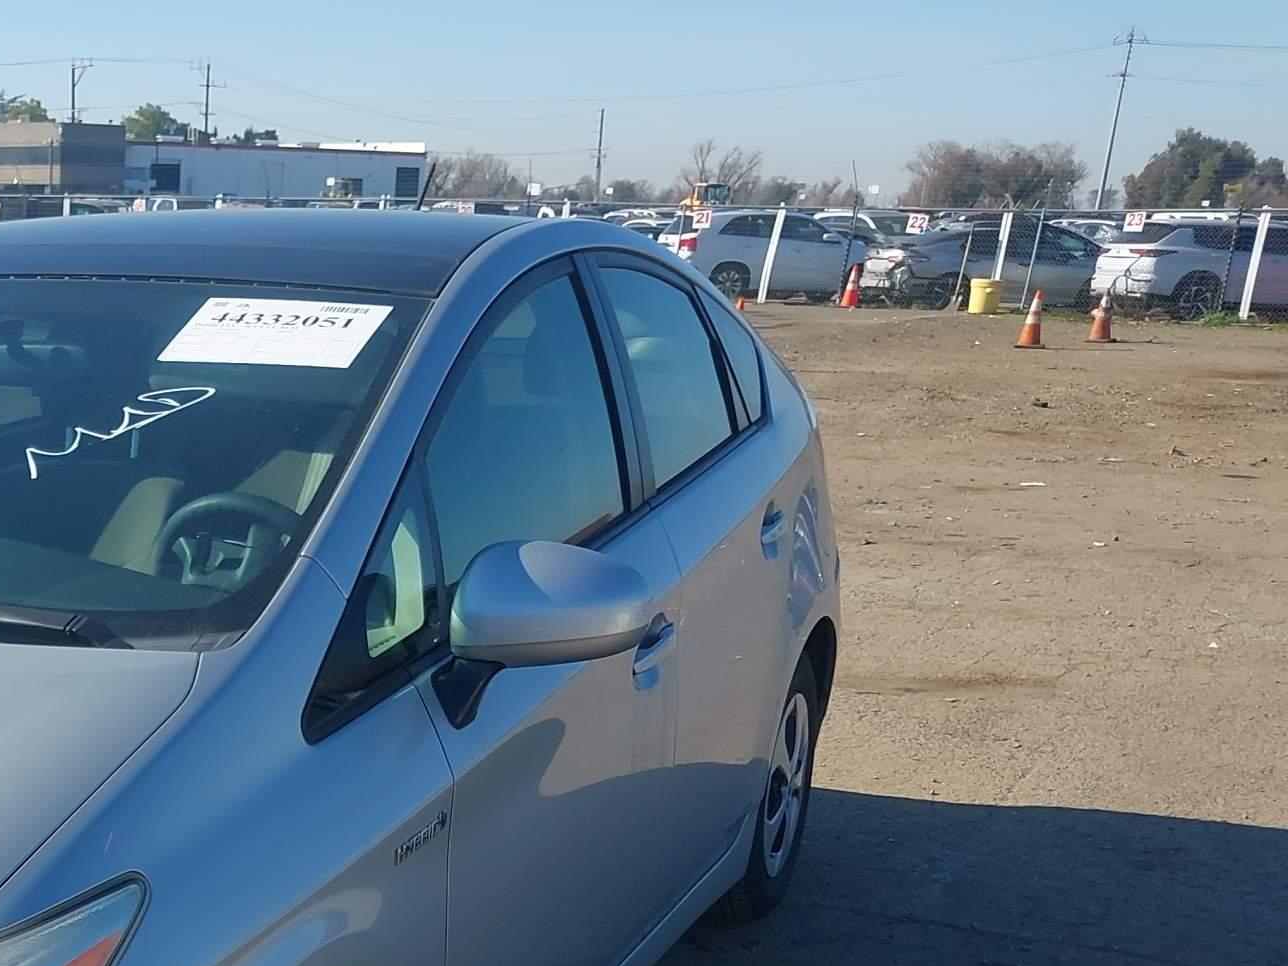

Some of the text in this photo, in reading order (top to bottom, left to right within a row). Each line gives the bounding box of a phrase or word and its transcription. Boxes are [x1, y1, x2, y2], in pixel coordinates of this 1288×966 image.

[695, 212, 710, 224] 21
[909, 216, 927, 228] 22
[1127, 213, 1144, 226] 23
[210, 312, 354, 328] 44332051
